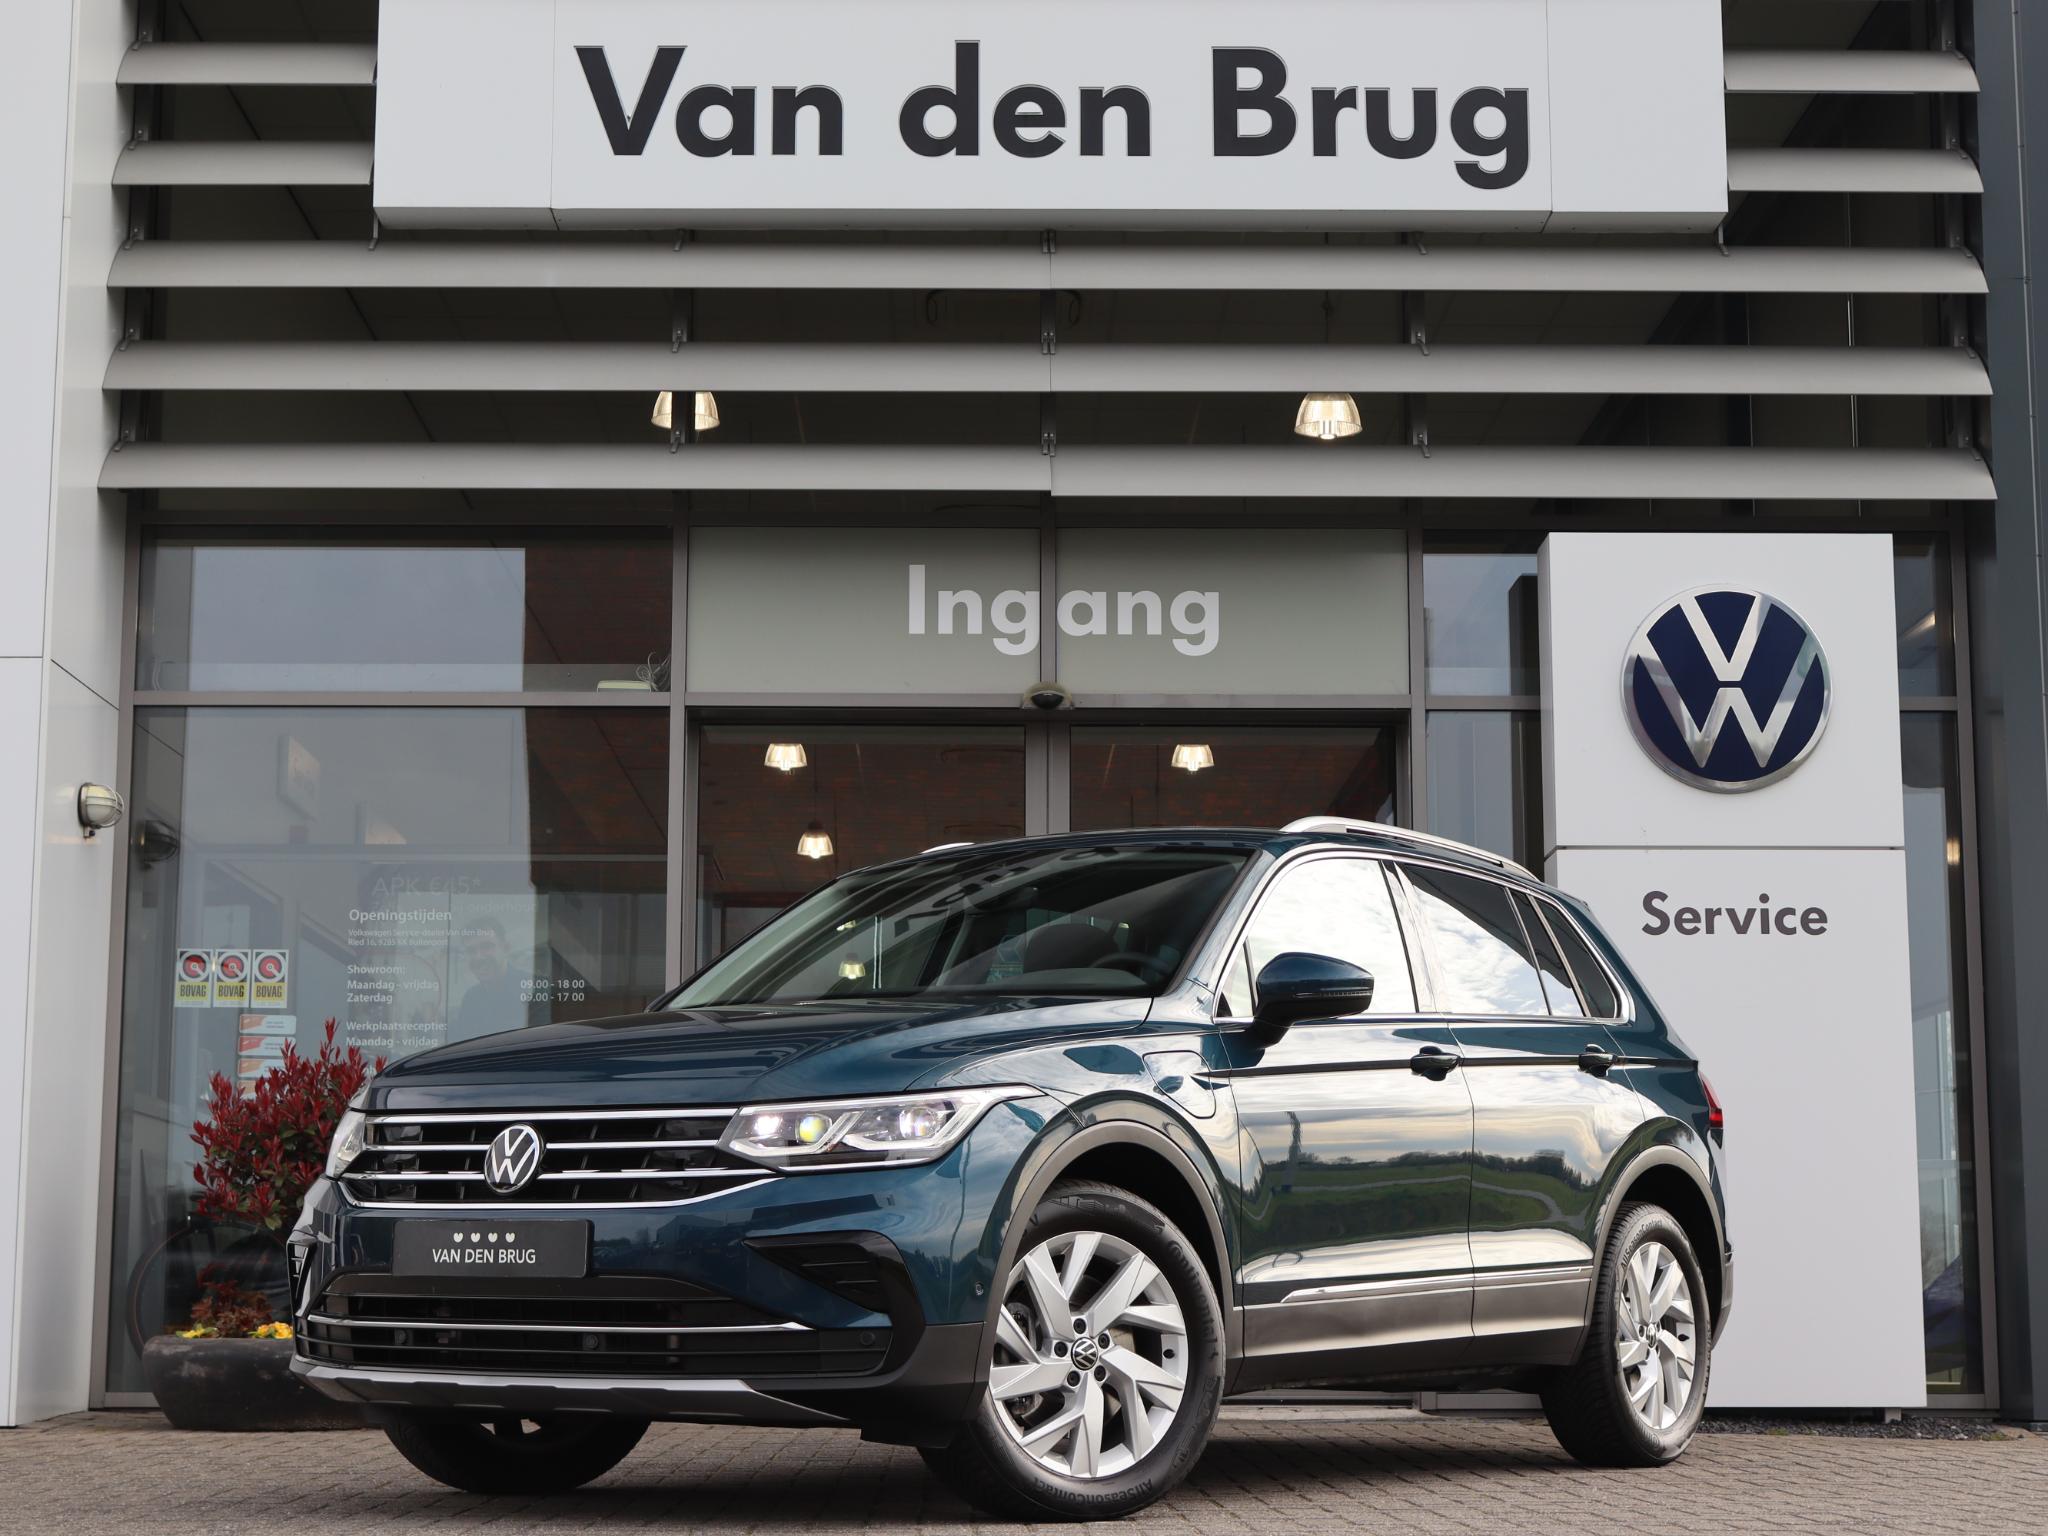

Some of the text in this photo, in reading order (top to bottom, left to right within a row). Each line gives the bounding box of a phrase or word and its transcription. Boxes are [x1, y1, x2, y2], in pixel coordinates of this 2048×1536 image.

[573, 39, 1531, 190] Van den Brug
[908, 564, 1219, 656] Ingang
[372, 876, 421, 897] APK
[349, 908, 452, 924] Openingstijden
[1642, 890, 1828, 936] Service
[347, 964, 406, 976] Showroom:
[180, 985, 207, 997] BOVAG
[218, 985, 245, 998] BOVAG
[256, 986, 282, 998] BOVAG
[347, 980, 395, 992] Maandag
[403, 980, 440, 993] vrijdag
[520, 979, 548, 989] 09.00
[347, 993, 393, 1005] Zaterdag
[520, 992, 548, 1002] 09.00
[346, 1021, 448, 1034] Werkplaatsreceptie:
[346, 1037, 394, 1048] Maandag
[402, 1036, 438, 1049] vrijdag
[432, 1249, 536, 1263] VAN DEN BRUG
[1033, 1477, 1154, 1505] AllSeasonContact
